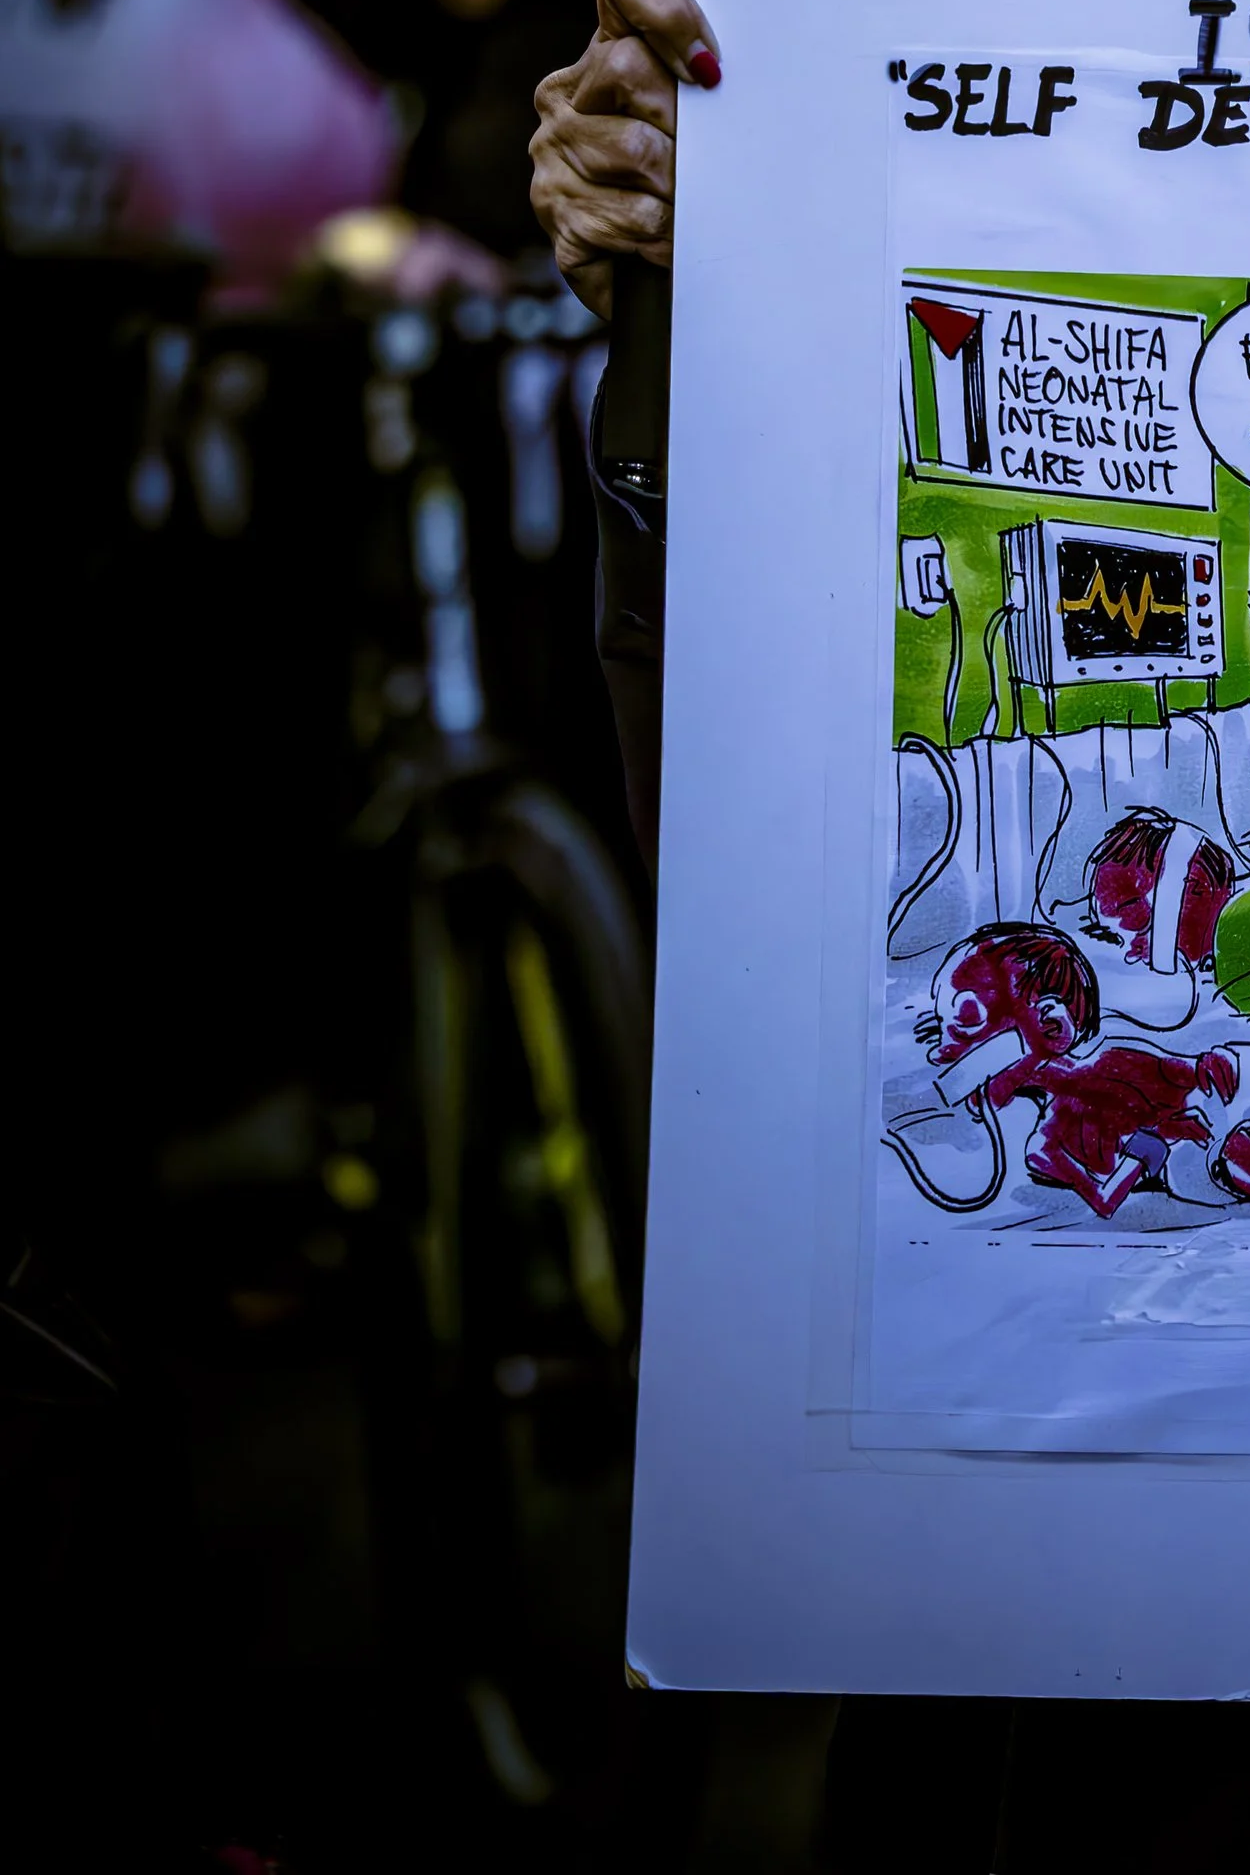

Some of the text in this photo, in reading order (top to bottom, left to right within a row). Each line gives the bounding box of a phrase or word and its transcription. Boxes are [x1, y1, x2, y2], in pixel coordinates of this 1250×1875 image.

[887, 59, 1078, 137] "SELF
[1000, 310, 1168, 374] AL-SHIFA
[998, 364, 1180, 418] NEONATAL
[998, 403, 1179, 453] INTENSIVE
[1000, 445, 1179, 495] CARE UNIT
